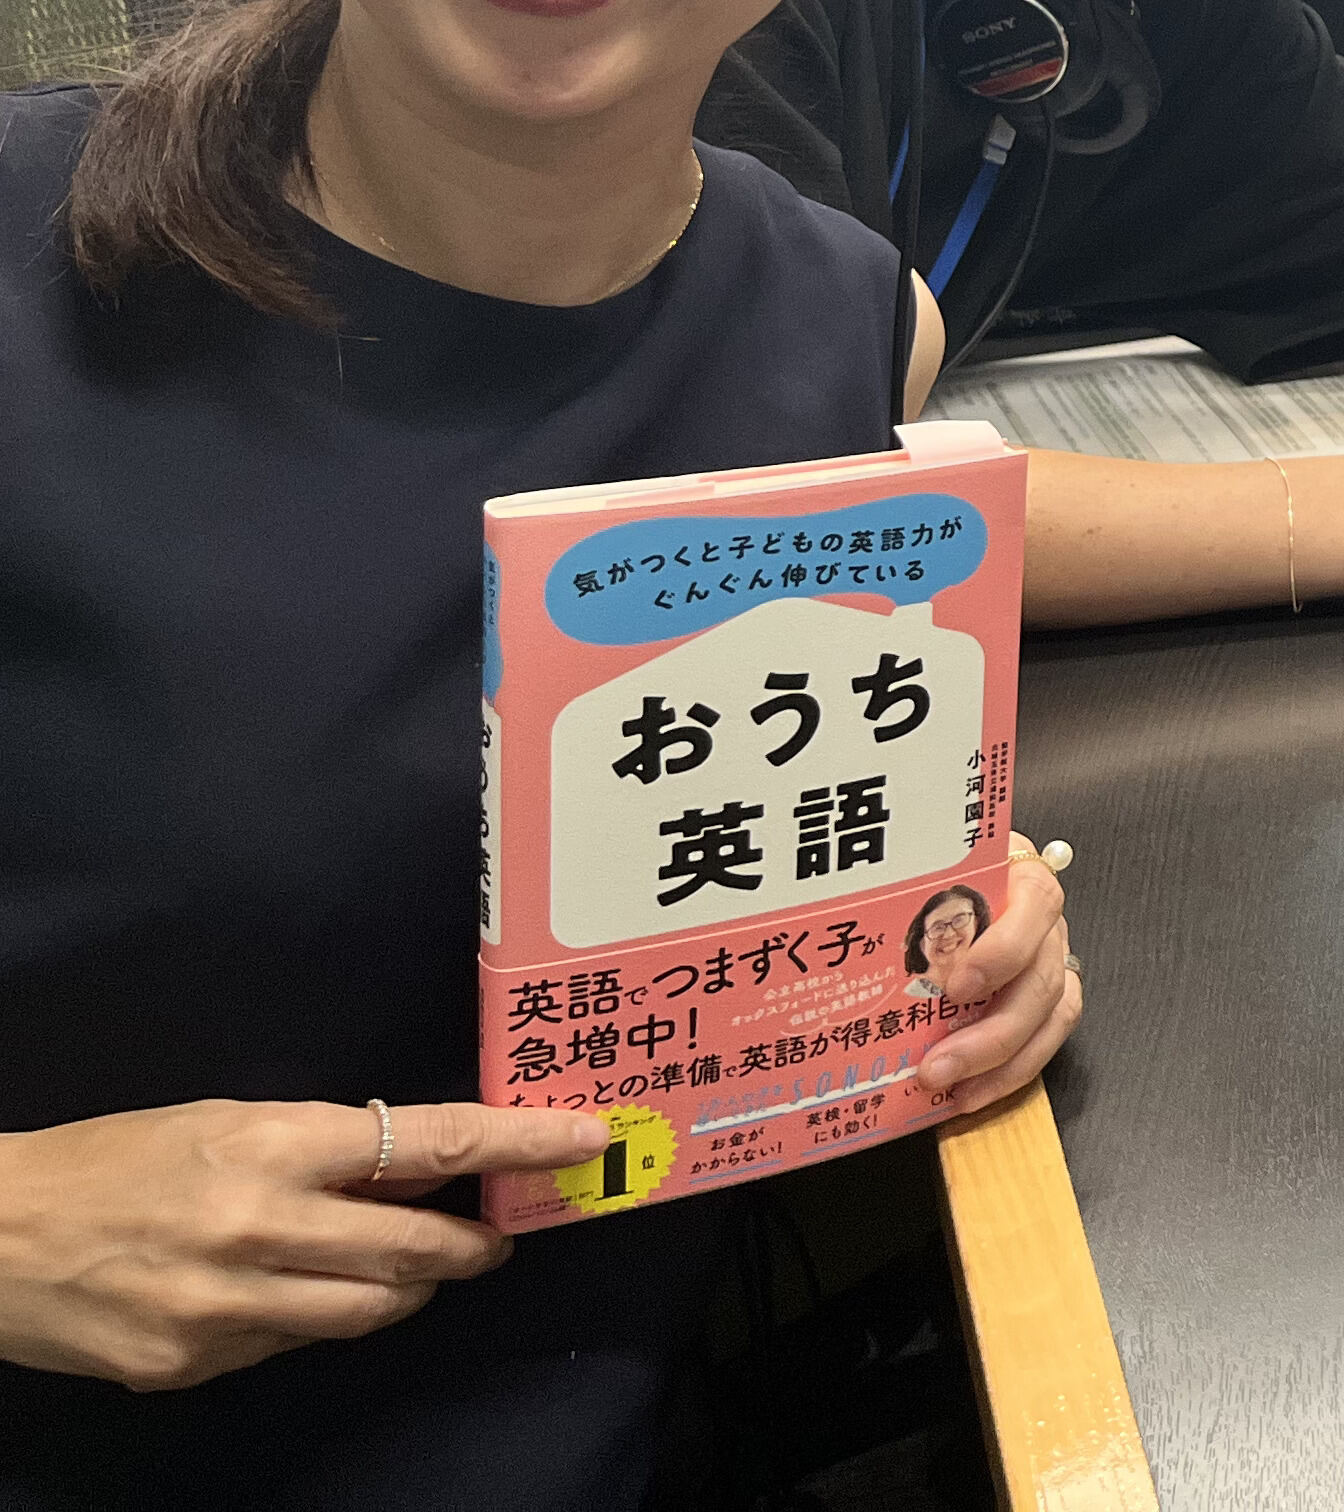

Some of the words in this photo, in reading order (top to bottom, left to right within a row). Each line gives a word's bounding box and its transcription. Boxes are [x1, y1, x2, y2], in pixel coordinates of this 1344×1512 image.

[572, 514, 964, 599] 気がつくと子どもの英語力が
[653, 559, 927, 611] ぐんぐん伸びている
[610, 652, 932, 786] おうち
[656, 774, 892, 908] 英語
[506, 920, 886, 1034] 英語でつまずく子が
[506, 1006, 699, 1086] 急増中!
[710, 1126, 766, 1153] お金が
